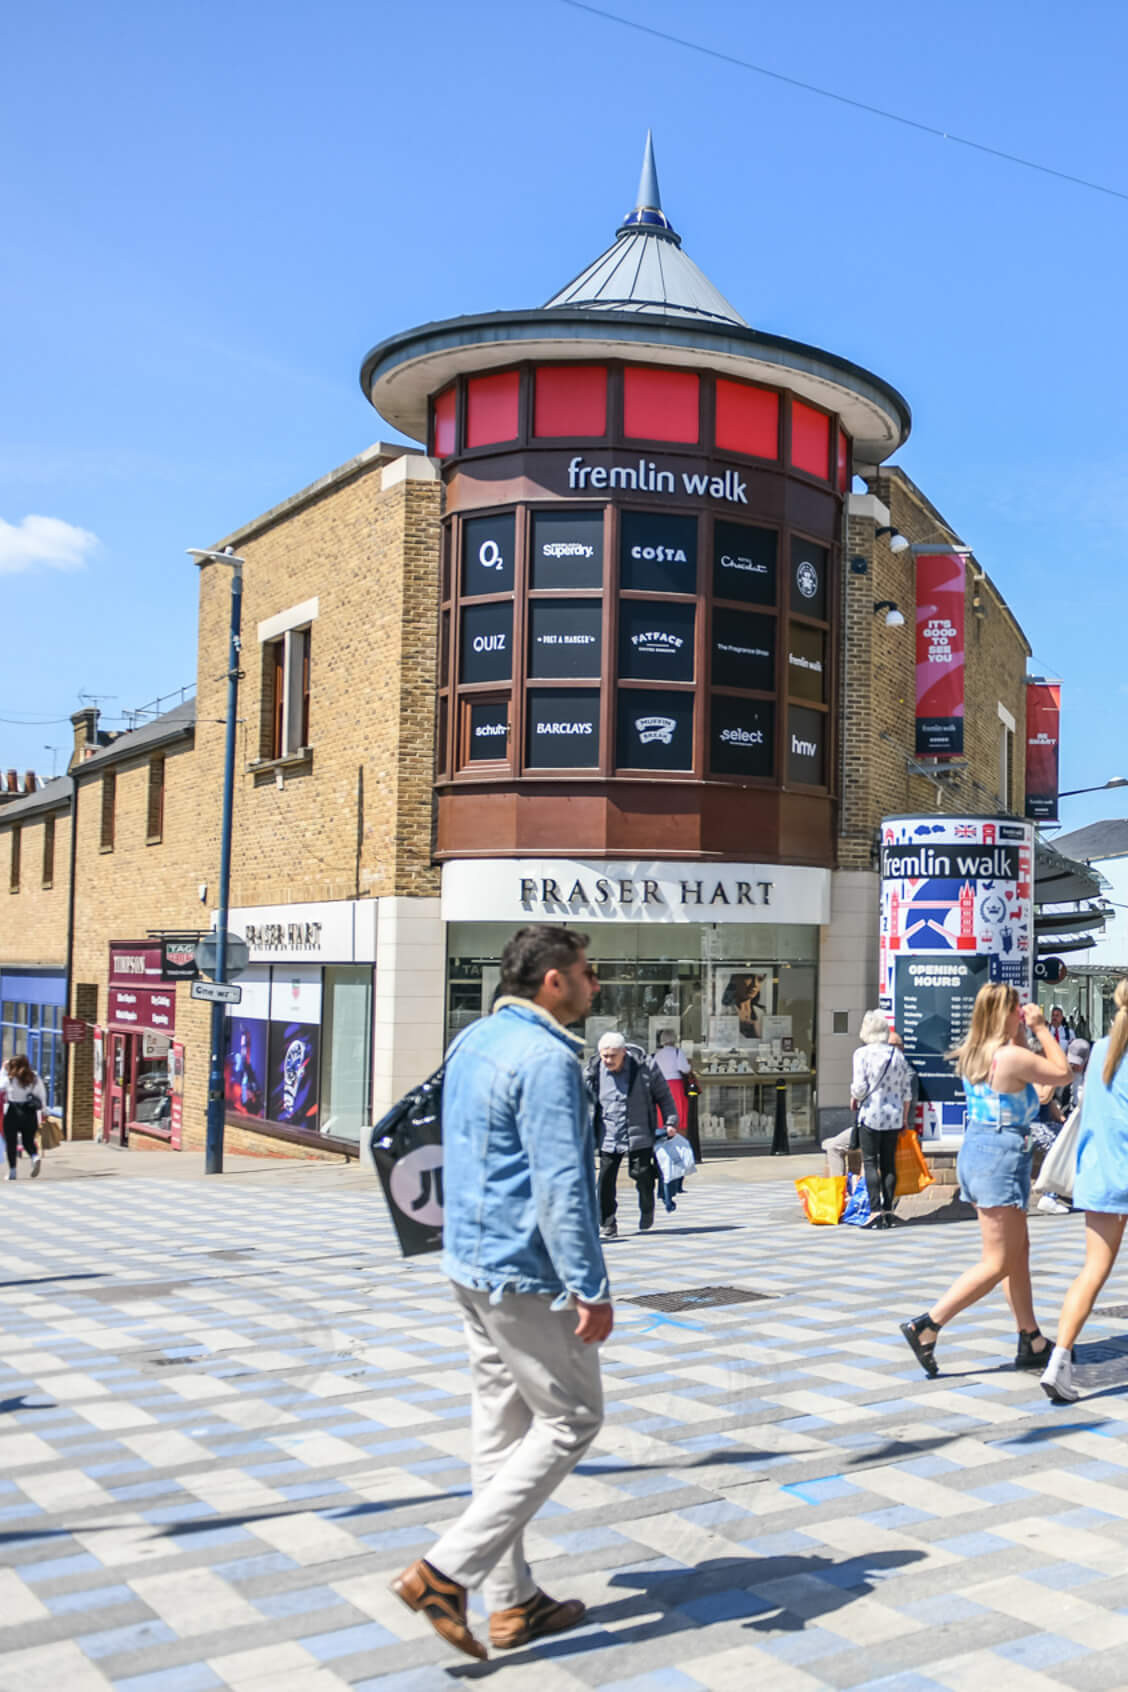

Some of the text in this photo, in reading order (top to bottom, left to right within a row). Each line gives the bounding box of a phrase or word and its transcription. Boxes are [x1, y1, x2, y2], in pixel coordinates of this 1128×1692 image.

[568, 457, 748, 504] fremlin walk
[631, 545, 687, 562] COSTA
[928, 620, 952, 628] IT'S
[923, 628, 957, 637] GOOD
[473, 634, 505, 652] QUIZ
[631, 632, 684, 648] FATFACE
[932, 637, 948, 645] TO
[928, 645, 951, 654] SEE
[928, 653, 952, 662] YOU
[536, 722, 593, 734] BARCLAYS
[721, 728, 763, 743] select
[792, 734, 817, 757] hmv
[883, 847, 1012, 877] fremlin walk
[519, 878, 774, 905] FRASER HART
[170, 944, 193, 953] TAG
[908, 964, 968, 976] OPENING
[914, 976, 961, 988] HOURS
